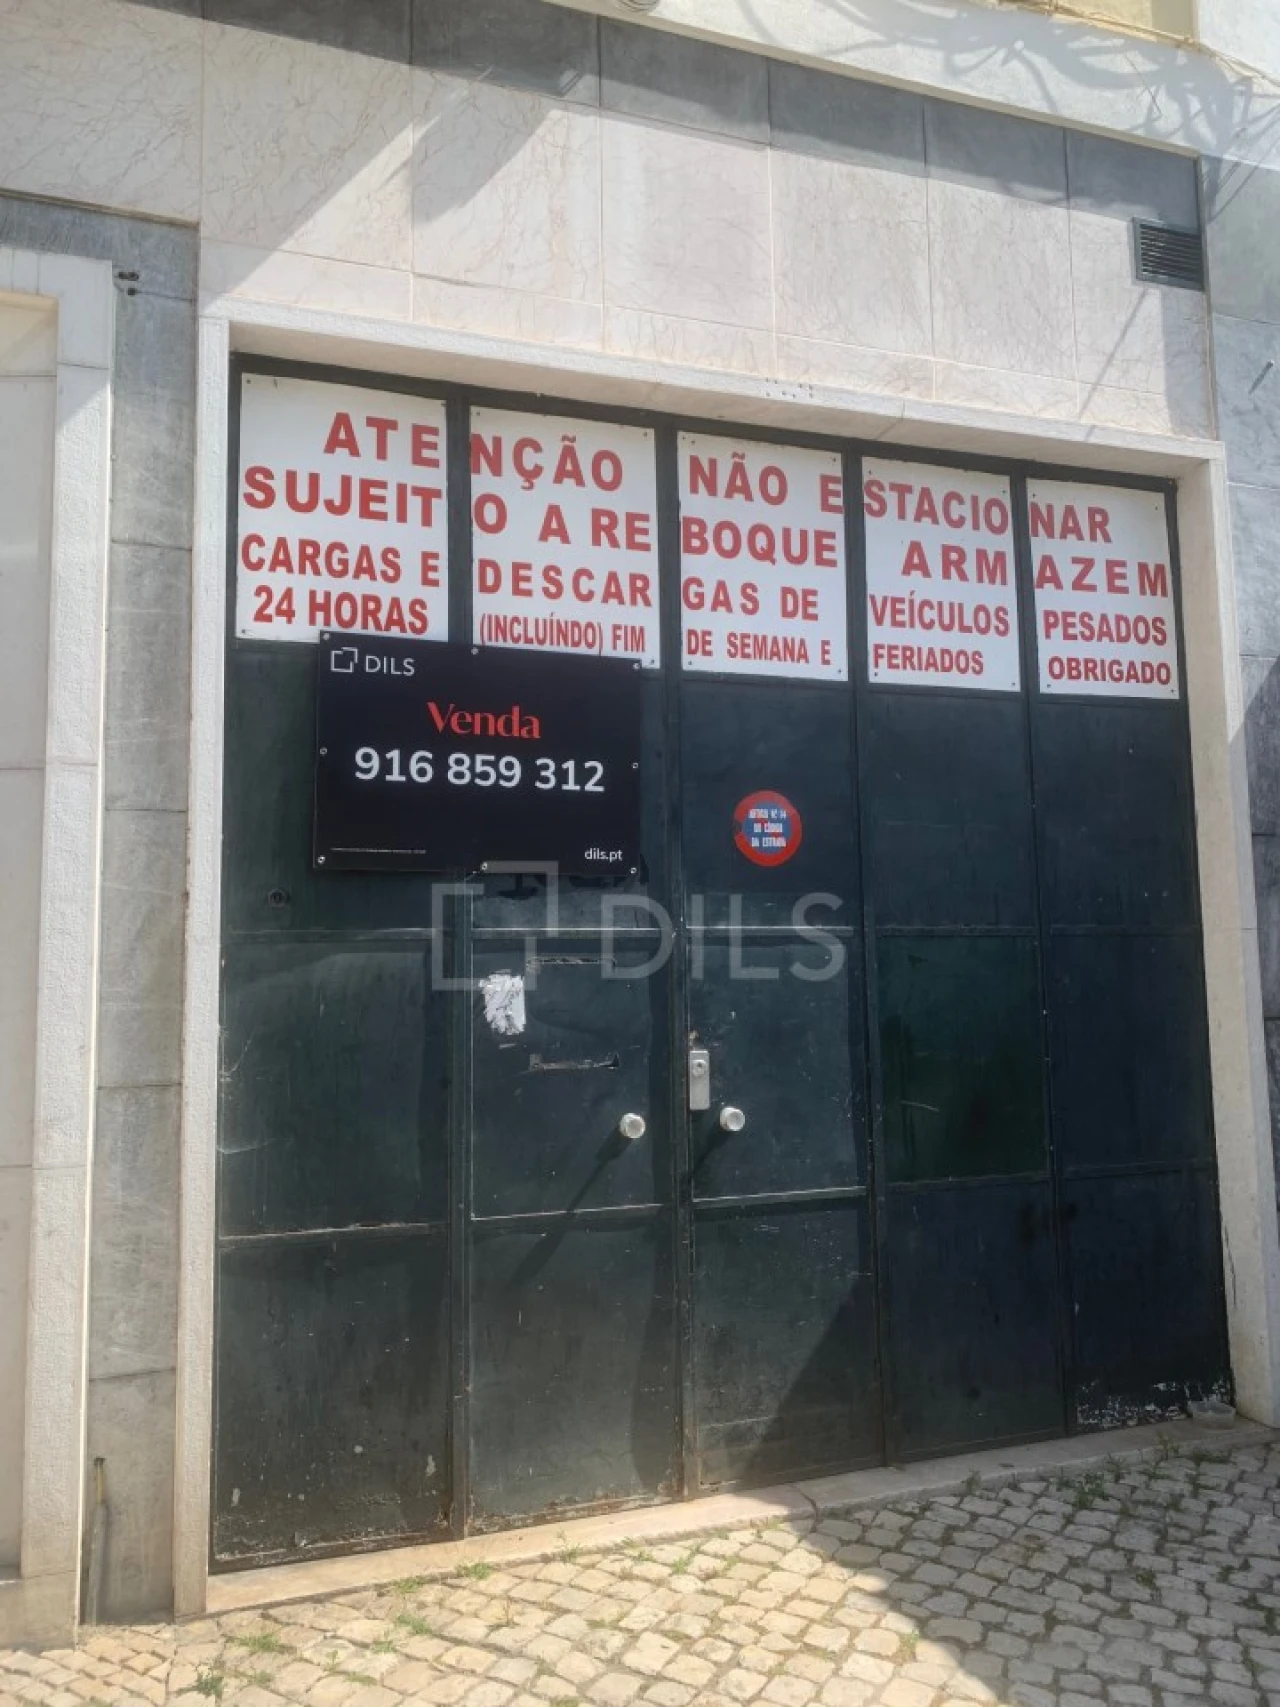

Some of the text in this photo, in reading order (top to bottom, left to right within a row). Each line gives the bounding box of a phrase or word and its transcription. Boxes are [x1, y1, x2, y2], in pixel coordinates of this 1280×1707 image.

[688, 451, 788, 507] NÃO
[241, 533, 402, 584] CARGAS
[420, 550, 441, 588] E
[780, 585, 819, 622] DE
[869, 589, 1010, 637] VEÍCULOS
[1043, 609, 1167, 646] PESADOS
[253, 584, 1172, 686] 24 HORAS (INCLUÍNDO) FIM DE SEMANA E FERIADOS OBRIGADO
[365, 655, 415, 677] DILS
[427, 701, 541, 740] Venda
[354, 746, 605, 793] 916 859 312
[584, 847, 623, 863] dils.pt
